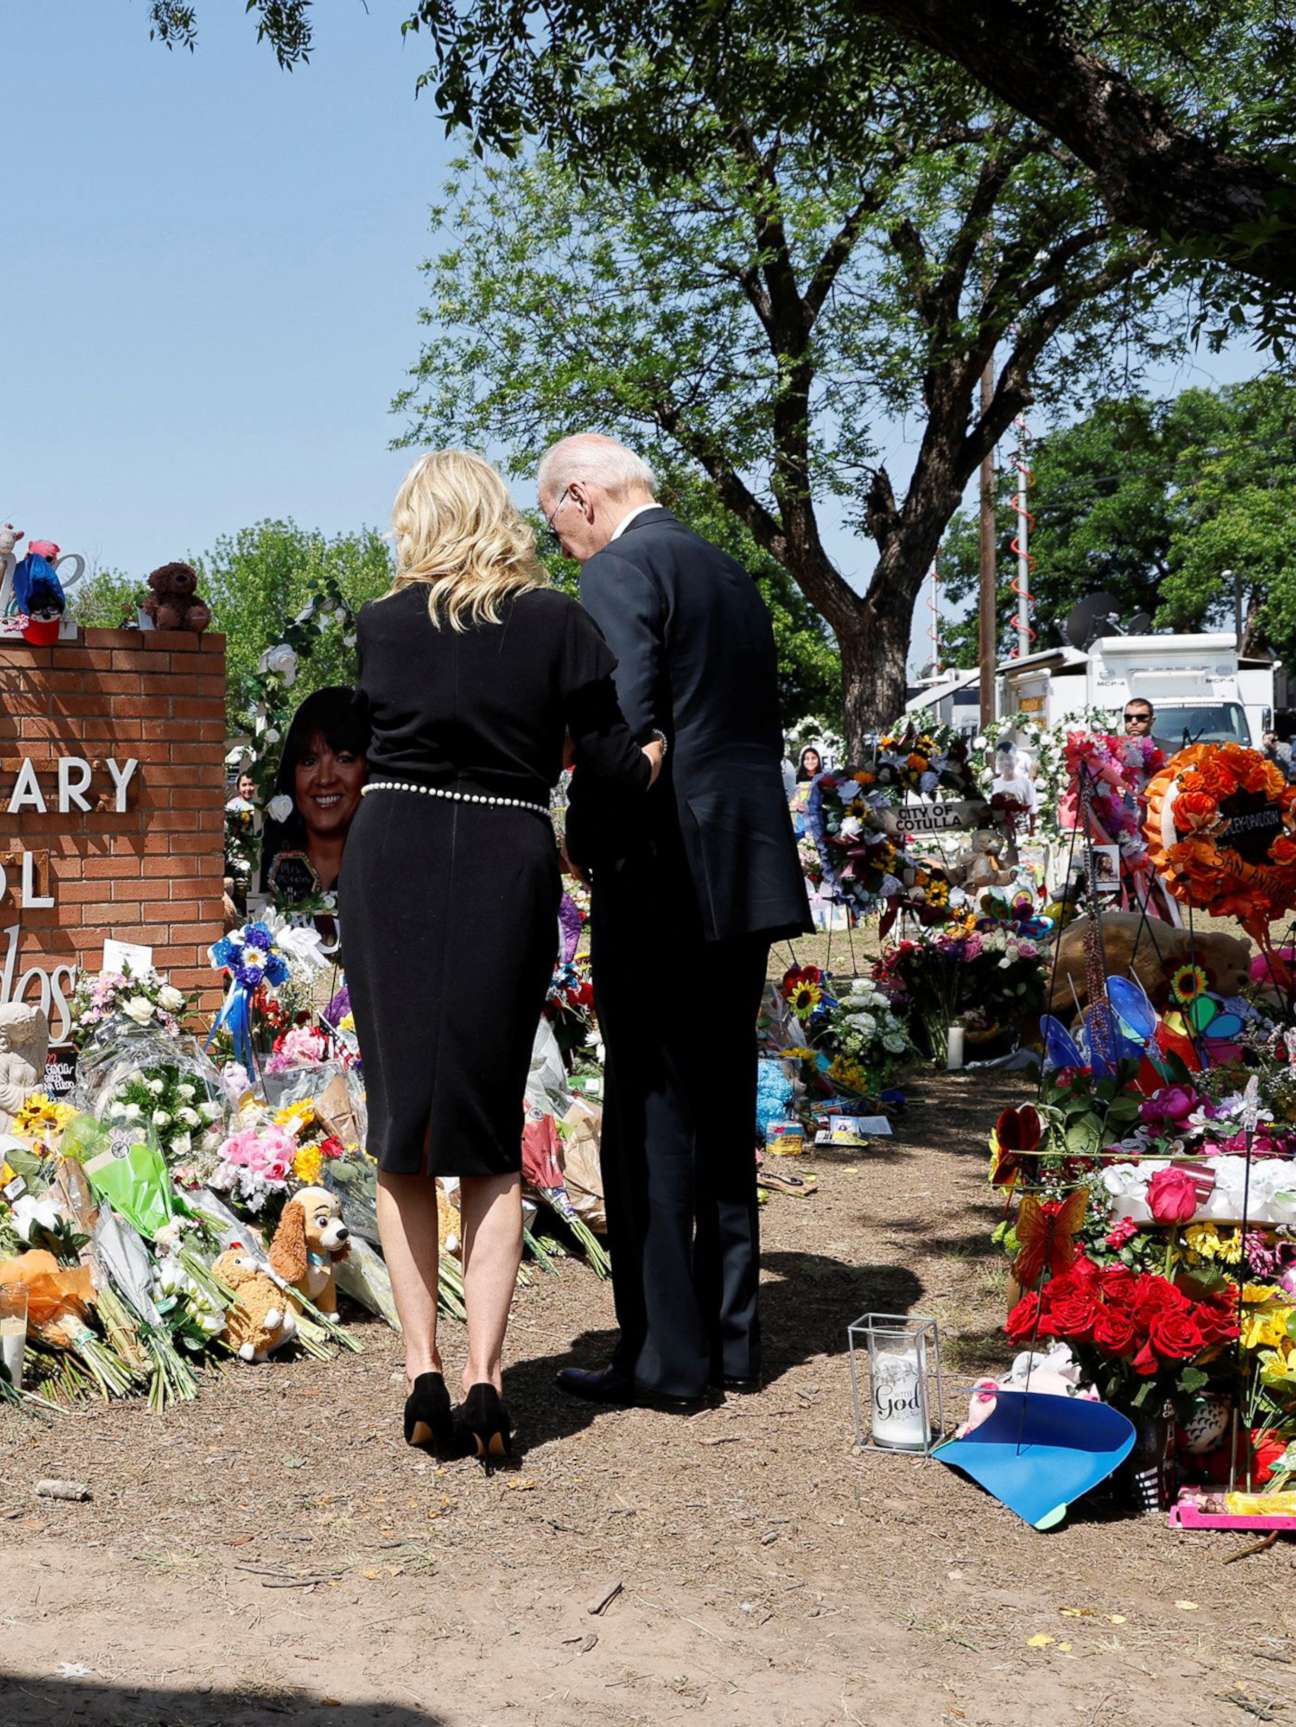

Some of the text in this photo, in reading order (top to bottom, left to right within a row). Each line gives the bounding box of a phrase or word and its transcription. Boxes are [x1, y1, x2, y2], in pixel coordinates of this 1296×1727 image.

[898, 804, 953, 820] CITY OF
[895, 815, 962, 832] COTULLA
[875, 1380, 920, 1421] God
